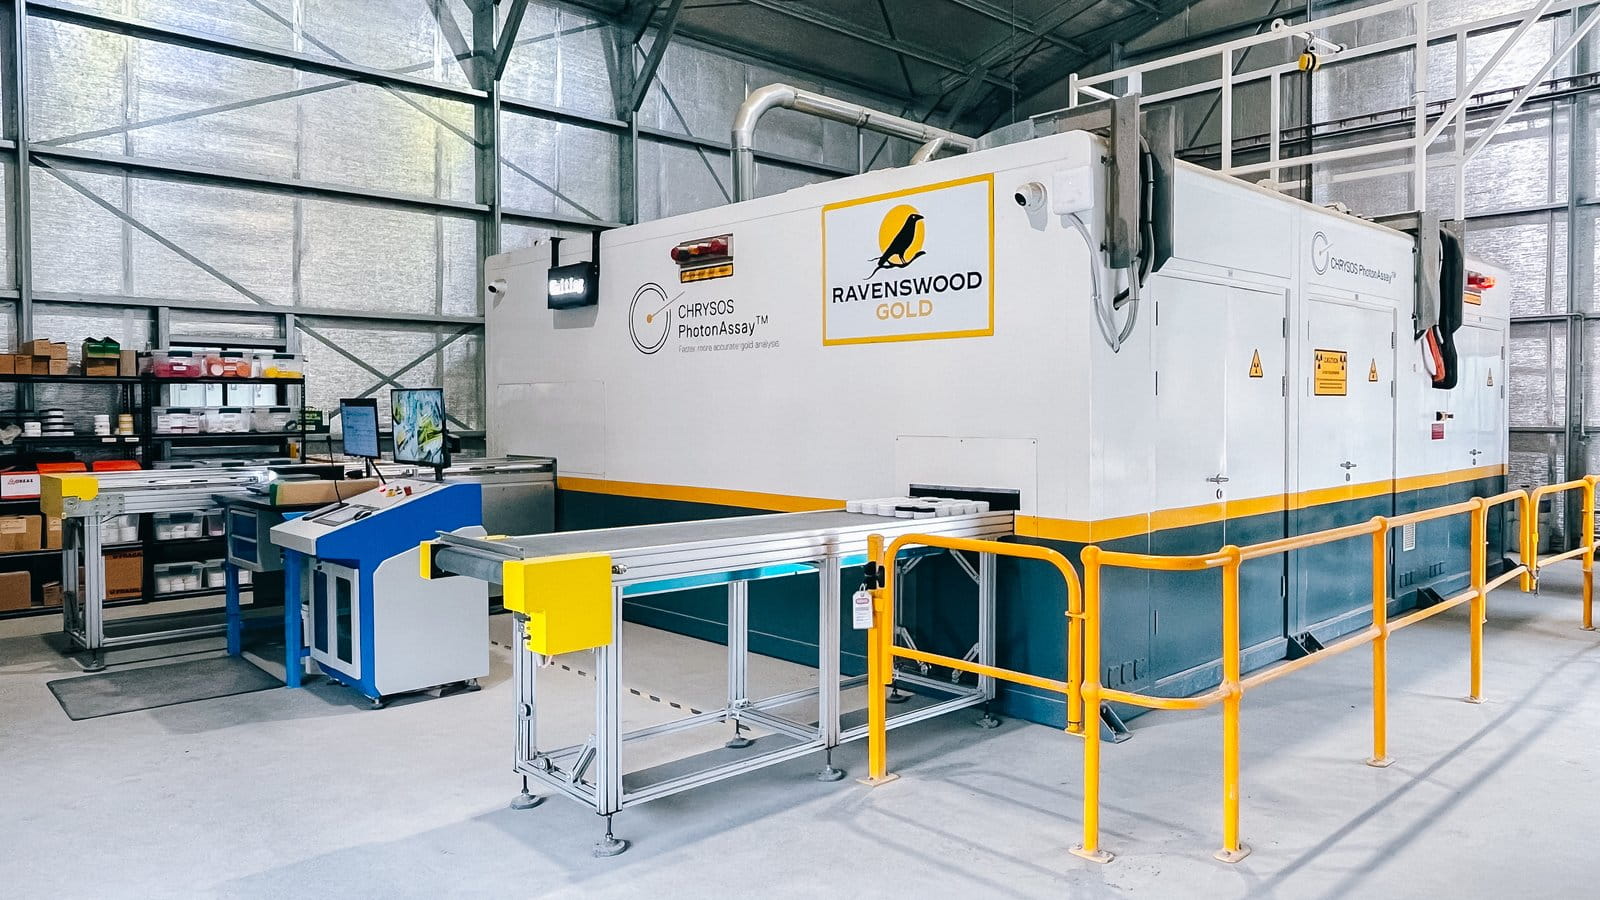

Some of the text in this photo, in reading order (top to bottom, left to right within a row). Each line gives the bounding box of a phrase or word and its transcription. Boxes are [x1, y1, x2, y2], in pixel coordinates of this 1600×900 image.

[832, 271, 983, 303] RAVENSWOOD
[678, 299, 735, 319] CHRYSOS
[876, 300, 933, 320] GOLD
[740, 340, 754, 351] gold
